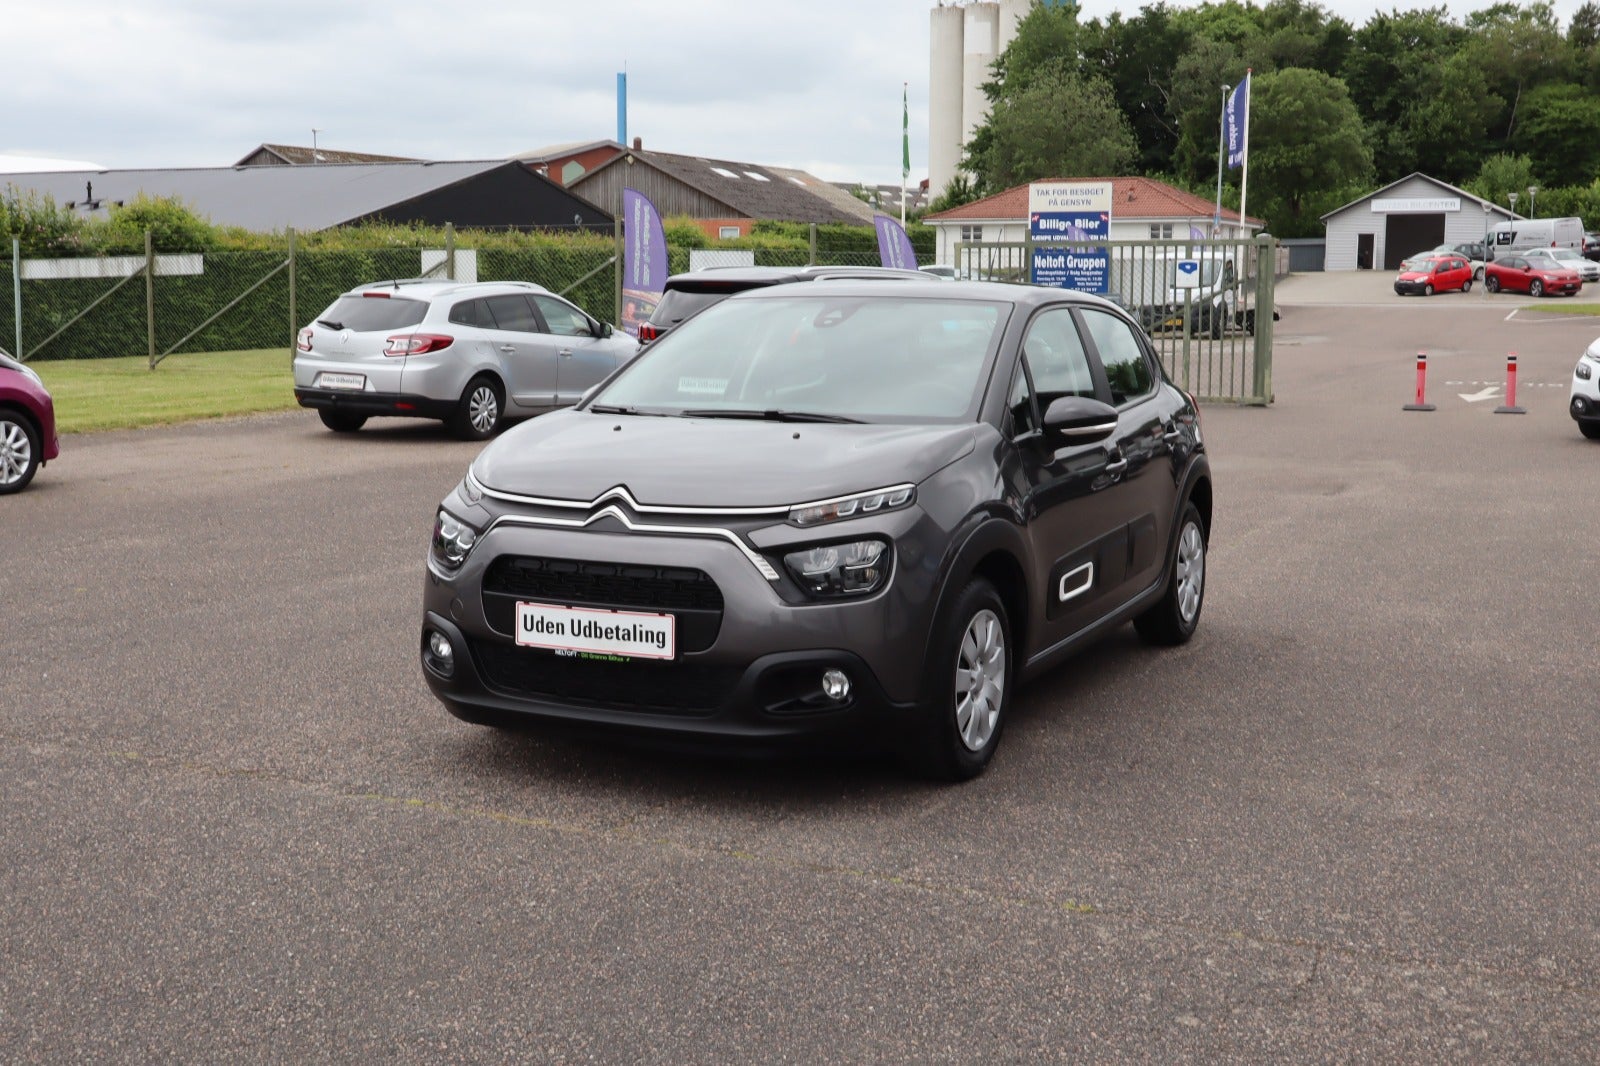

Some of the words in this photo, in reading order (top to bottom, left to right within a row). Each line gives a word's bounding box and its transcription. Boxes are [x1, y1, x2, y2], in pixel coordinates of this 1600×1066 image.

[1070, 188, 1104, 196] BESØGET
[1040, 218, 1072, 230] Billige
[1074, 218, 1100, 229] Biler
[1034, 255, 1065, 268] Neltoft
[1066, 255, 1106, 270] Gruppen
[523, 613, 565, 636] Uden
[570, 618, 666, 649] Udbetaling
